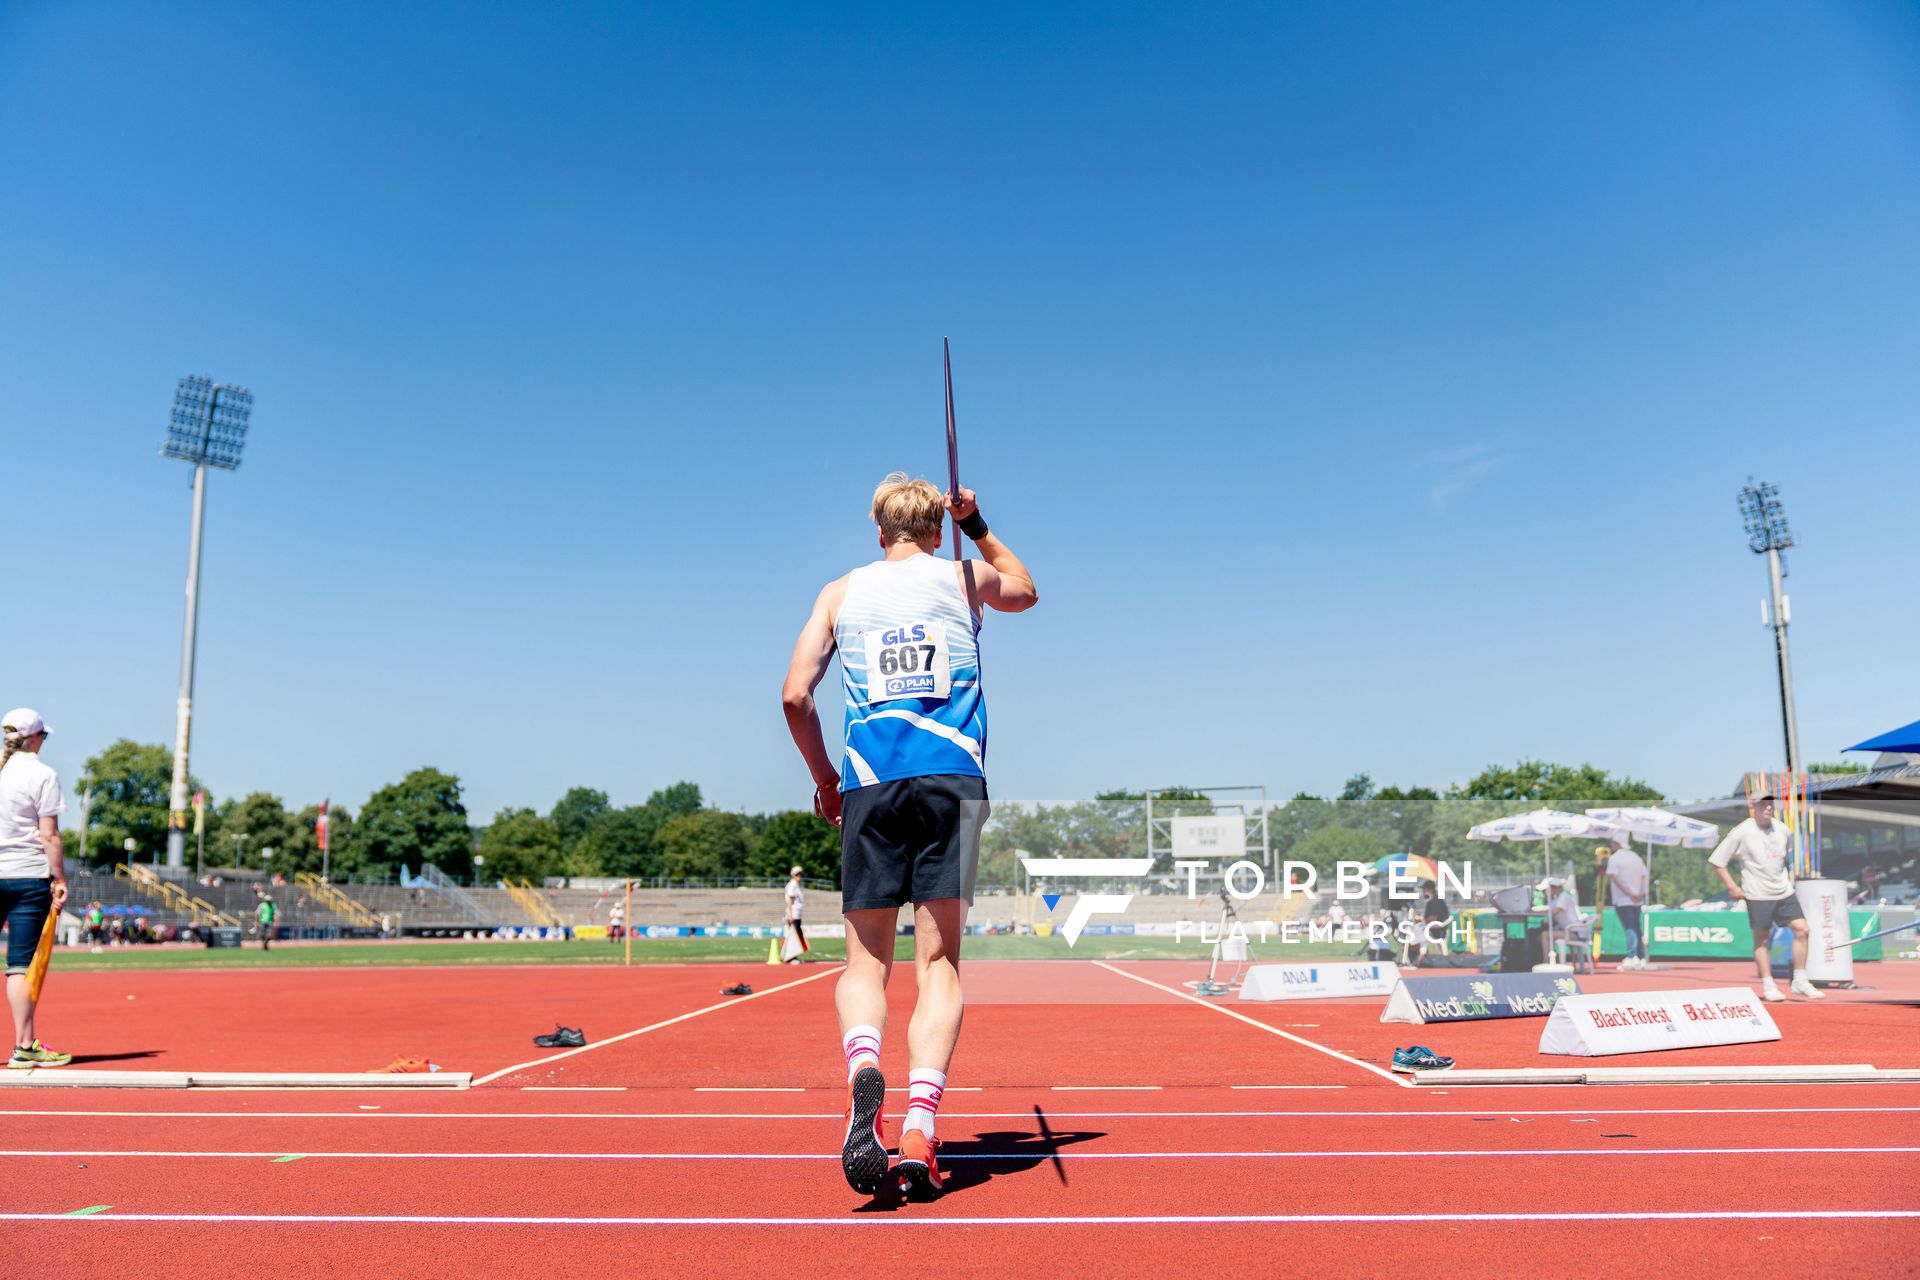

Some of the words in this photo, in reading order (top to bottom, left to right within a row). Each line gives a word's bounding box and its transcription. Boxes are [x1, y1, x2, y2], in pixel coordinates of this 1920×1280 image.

[879, 645, 936, 675] 607
[906, 678, 933, 687] PLAN
[1654, 926, 1729, 943] BENZ
[1282, 971, 1309, 985] ANA
[1348, 968, 1371, 981] ANA
[1416, 996, 1491, 1018] Mediclix
[1506, 992, 1559, 1014] Medic
[1715, 1002, 1756, 1019] Forest
[1588, 1009, 1628, 1028] Black
[1627, 1007, 1672, 1025] Forest
